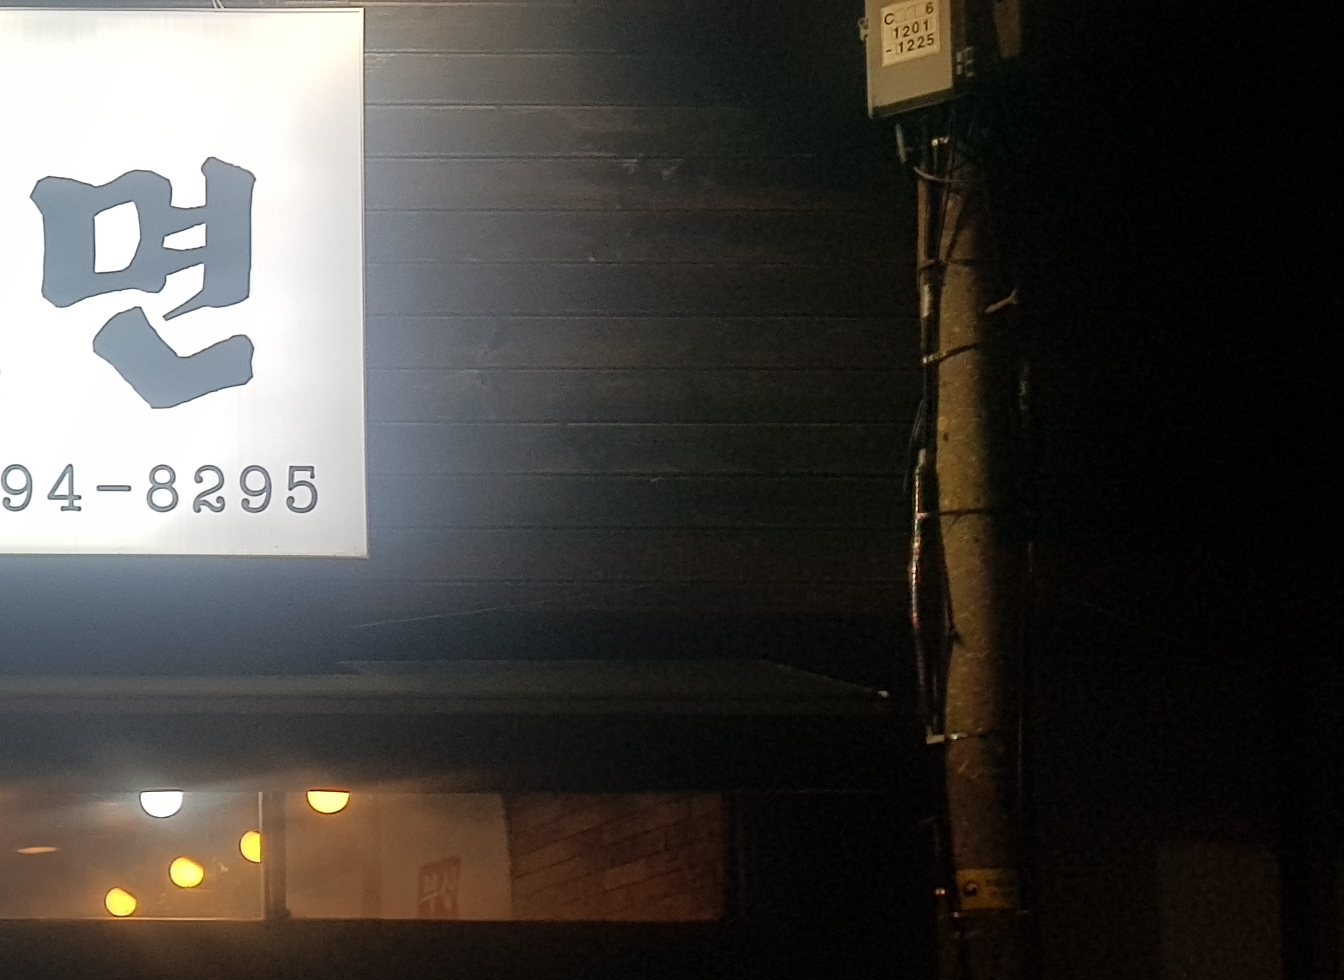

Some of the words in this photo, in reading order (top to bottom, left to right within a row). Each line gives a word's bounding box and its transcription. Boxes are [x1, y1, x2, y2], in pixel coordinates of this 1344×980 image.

[884, 13, 895, 26] C
[926, 2, 934, 15] 6
[894, 20, 929, 38] 1201
